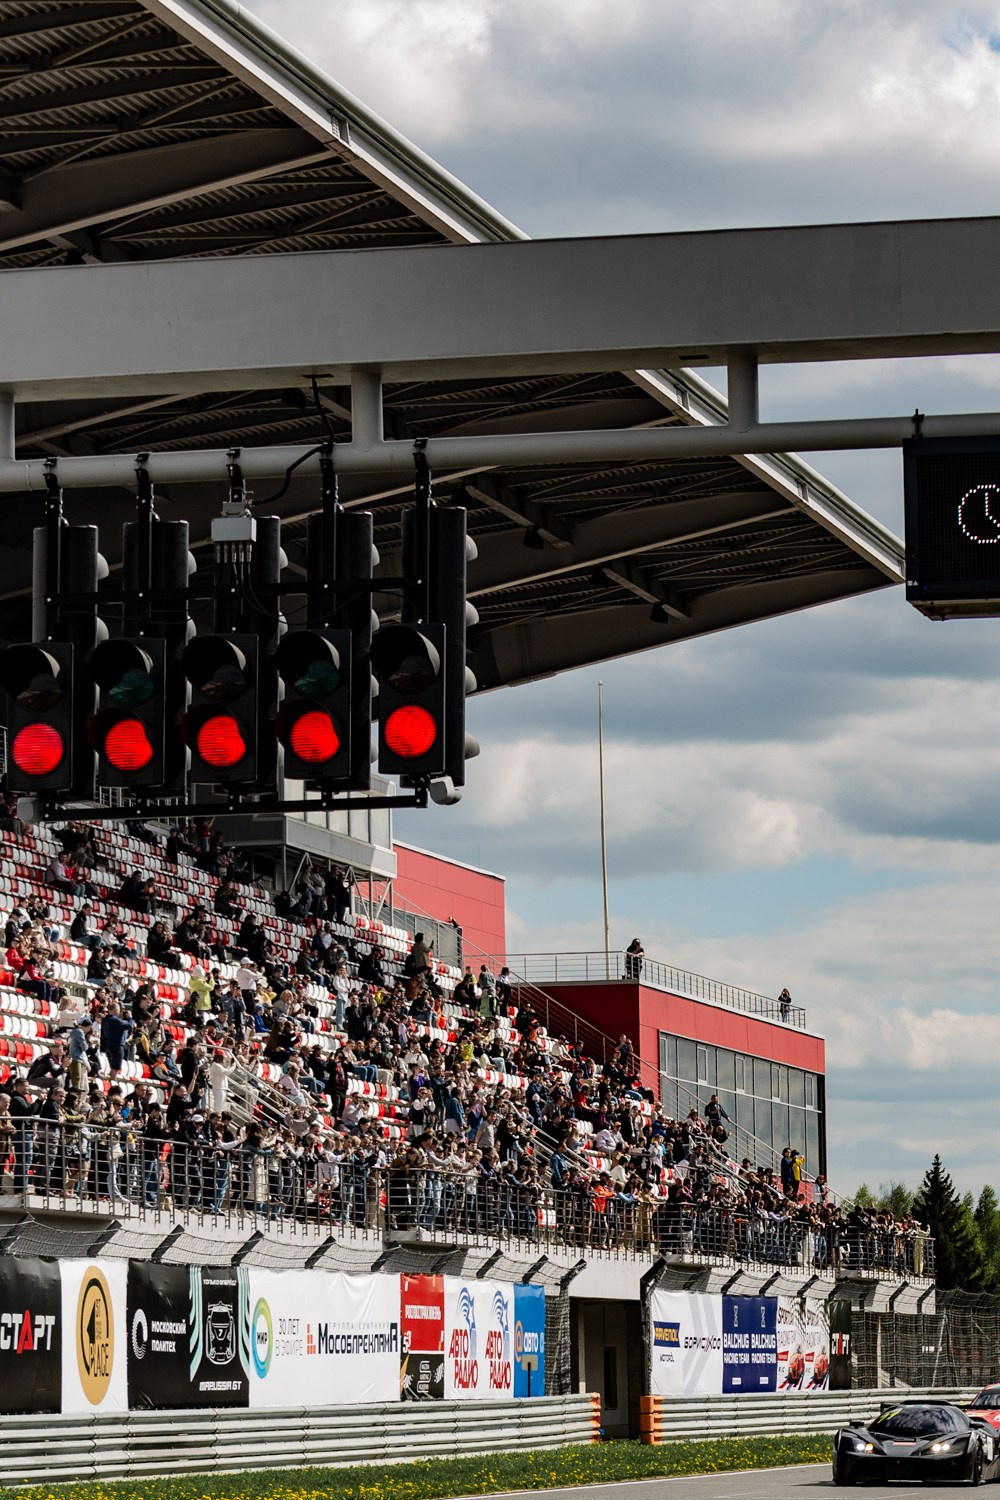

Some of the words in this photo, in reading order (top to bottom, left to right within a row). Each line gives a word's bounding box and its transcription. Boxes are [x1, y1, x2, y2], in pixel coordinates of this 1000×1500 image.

[0, 1309, 56, 1354] СТАРТ
[151, 1319, 187, 1335] МОСКОВСКИЙ
[279, 1318, 287, 1335] 30
[288, 1318, 300, 1335] ЛЕТ
[655, 1327, 679, 1341] RAVENOL
[257, 1332, 268, 1344] МИР
[448, 1329, 469, 1358] АВТО
[485, 1331, 502, 1359] АВТО
[723, 1333, 750, 1349] BALCHUG
[751, 1334, 776, 1349] BALCHUG
[281, 1339, 303, 1356] ЭФИРЕ
[723, 1353, 739, 1363] RACING
[739, 1353, 750, 1363] TEAM
[751, 1353, 766, 1363] RACING
[766, 1353, 776, 1363] TEAM
[454, 1360, 479, 1389] РАДИО
[489, 1361, 512, 1390] РАДИО
[199, 1381, 232, 1391] MARUSSIA
[232, 1381, 242, 1390] GT
